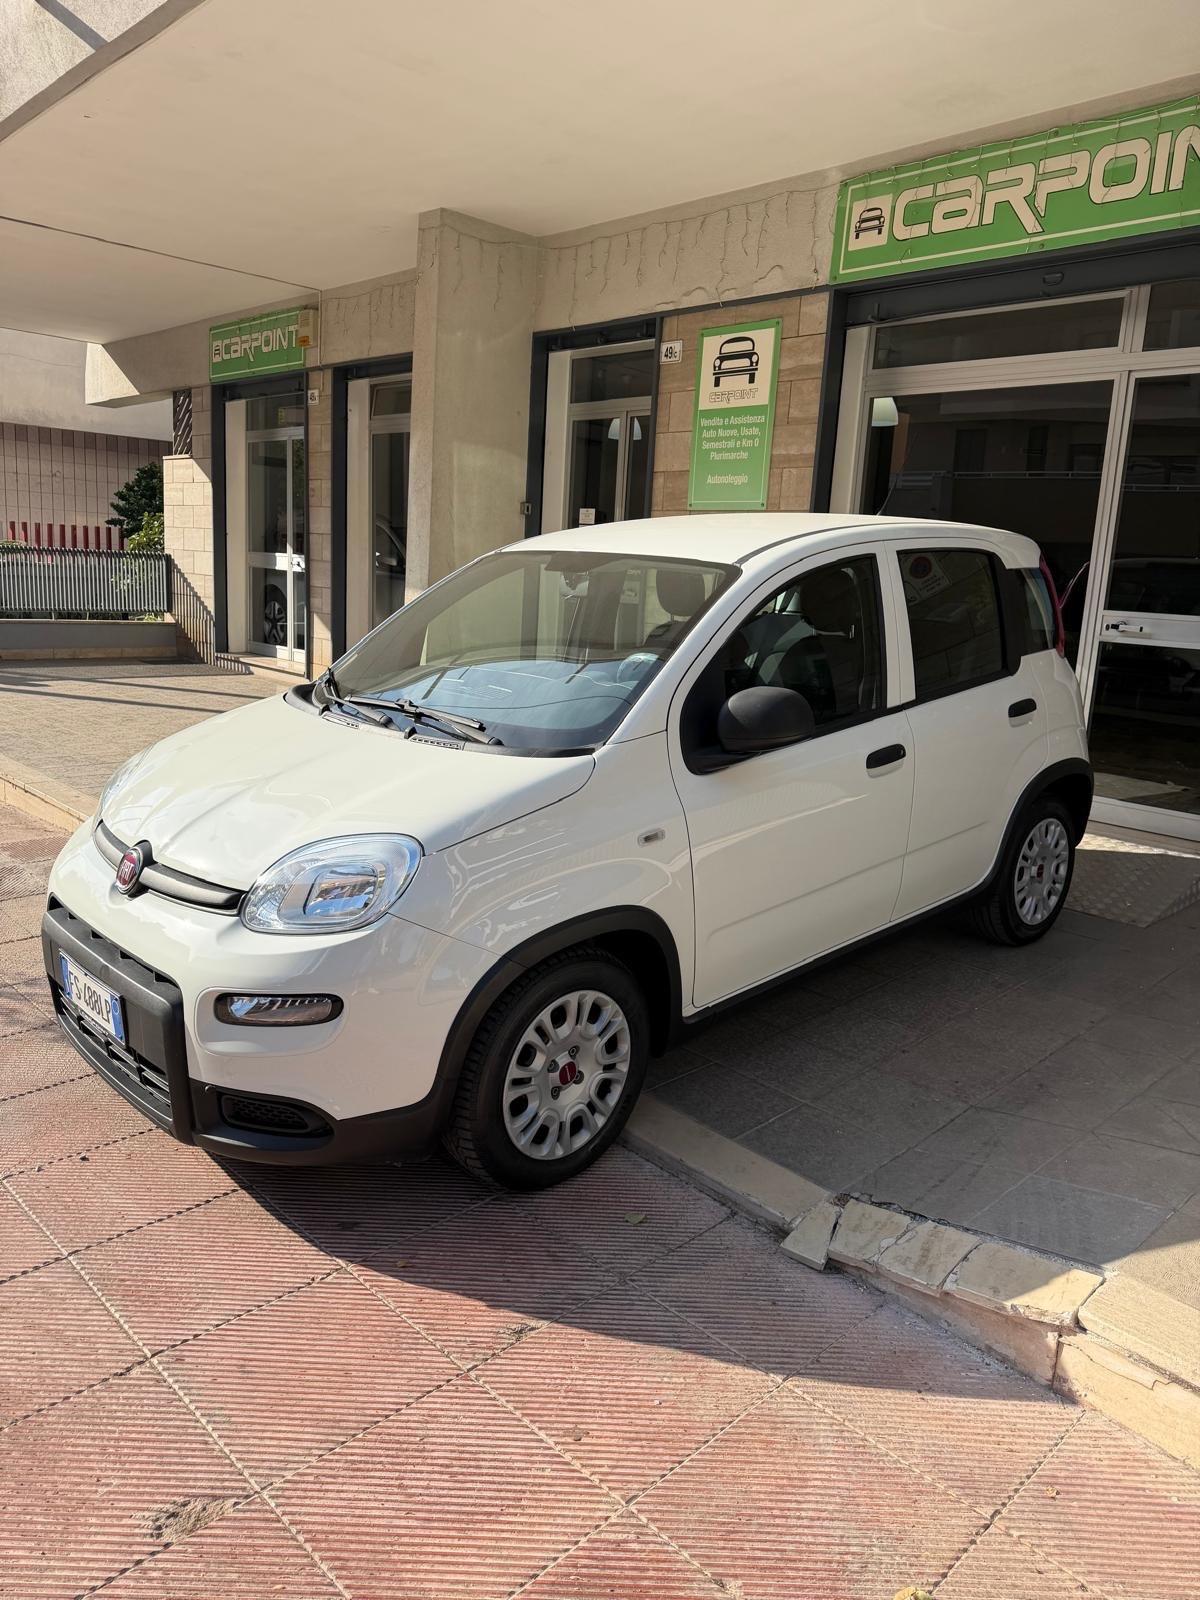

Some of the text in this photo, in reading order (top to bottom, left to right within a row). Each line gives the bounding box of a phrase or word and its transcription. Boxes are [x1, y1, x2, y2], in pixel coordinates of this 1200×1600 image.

[700, 416, 724, 427] Vendita
[730, 415, 765, 425] Assistenza
[702, 429, 717, 438] Auto
[702, 439, 736, 449] Semestrali
[736, 440, 741, 448] e
[742, 438, 753, 447] Km
[710, 450, 749, 460] Plurimarche
[707, 473, 748, 486] Autonoleggio
